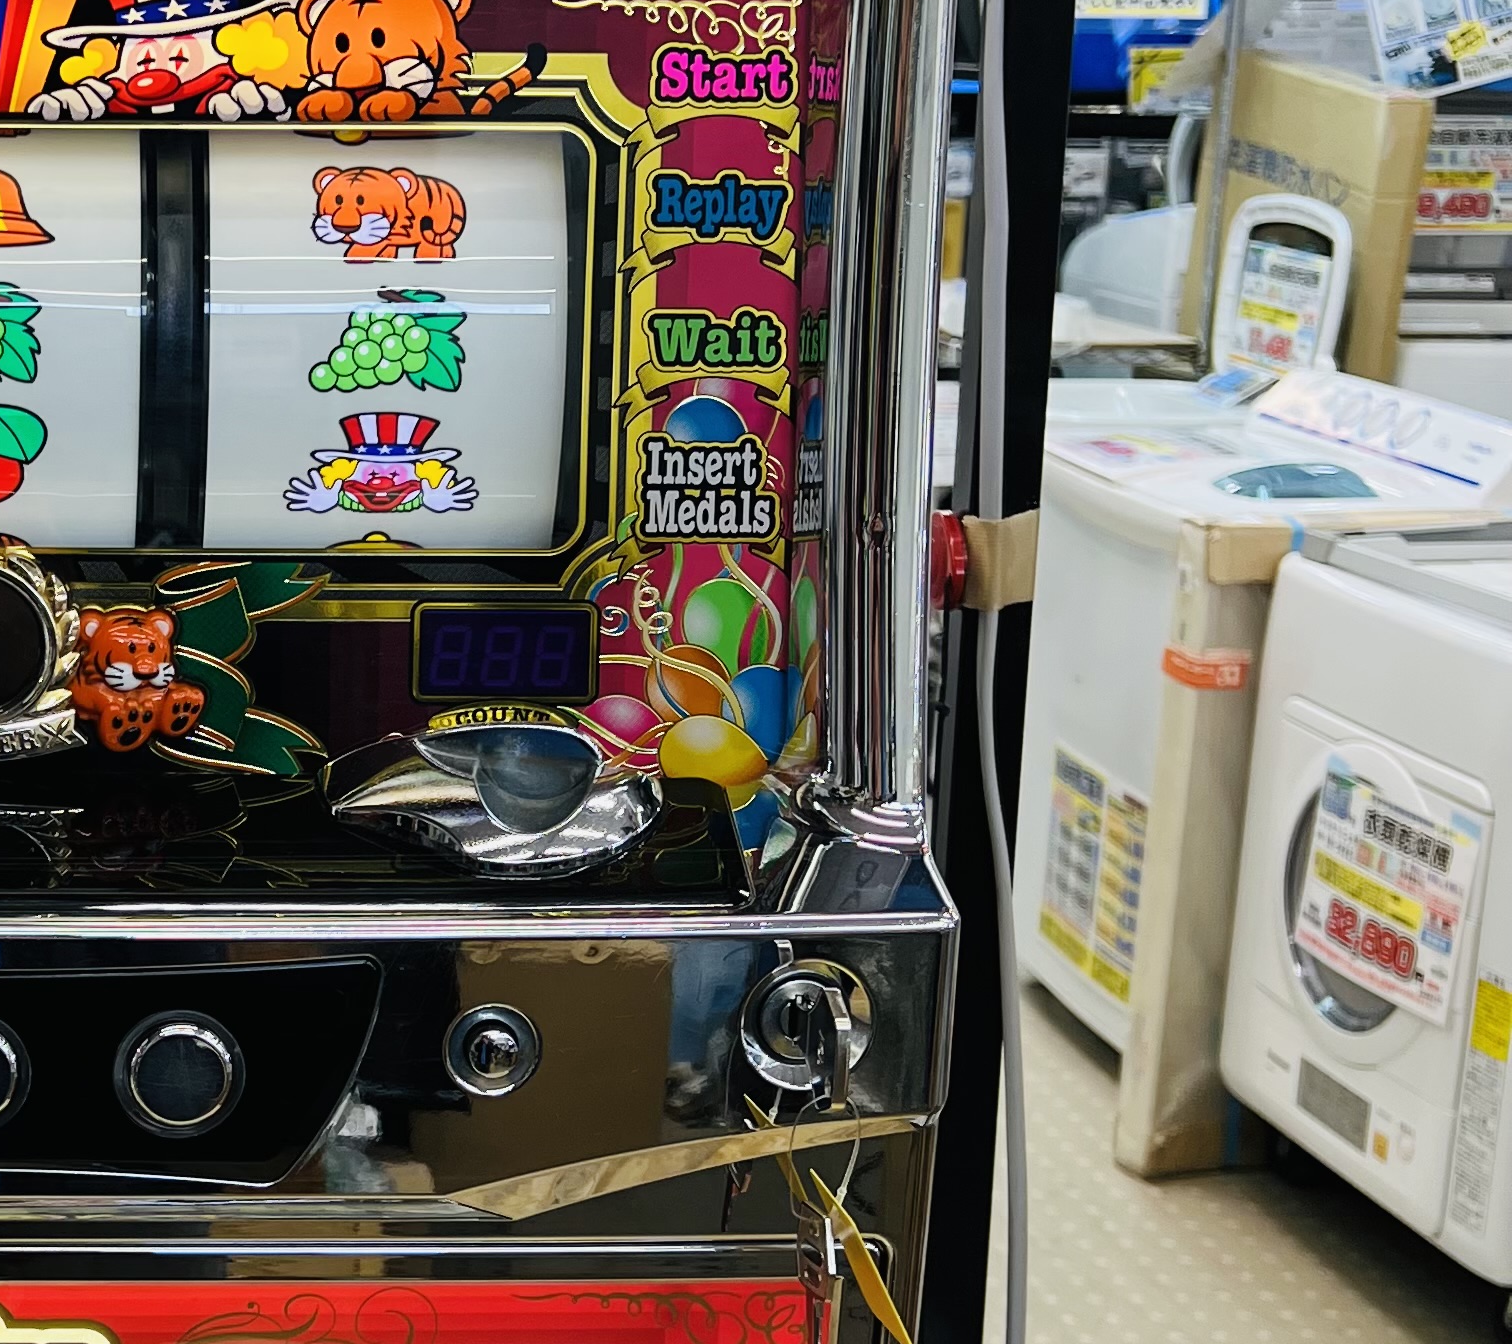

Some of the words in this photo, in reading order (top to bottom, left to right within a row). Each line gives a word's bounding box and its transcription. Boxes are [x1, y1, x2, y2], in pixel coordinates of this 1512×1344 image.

[658, 50, 790, 102] Start
[654, 178, 787, 235] Replay
[652, 315, 780, 364] Wait
[645, 441, 759, 487] Insert
[645, 487, 772, 535] Medals
[455, 706, 551, 726] COUNT
[1324, 898, 1418, 981] 32,890
